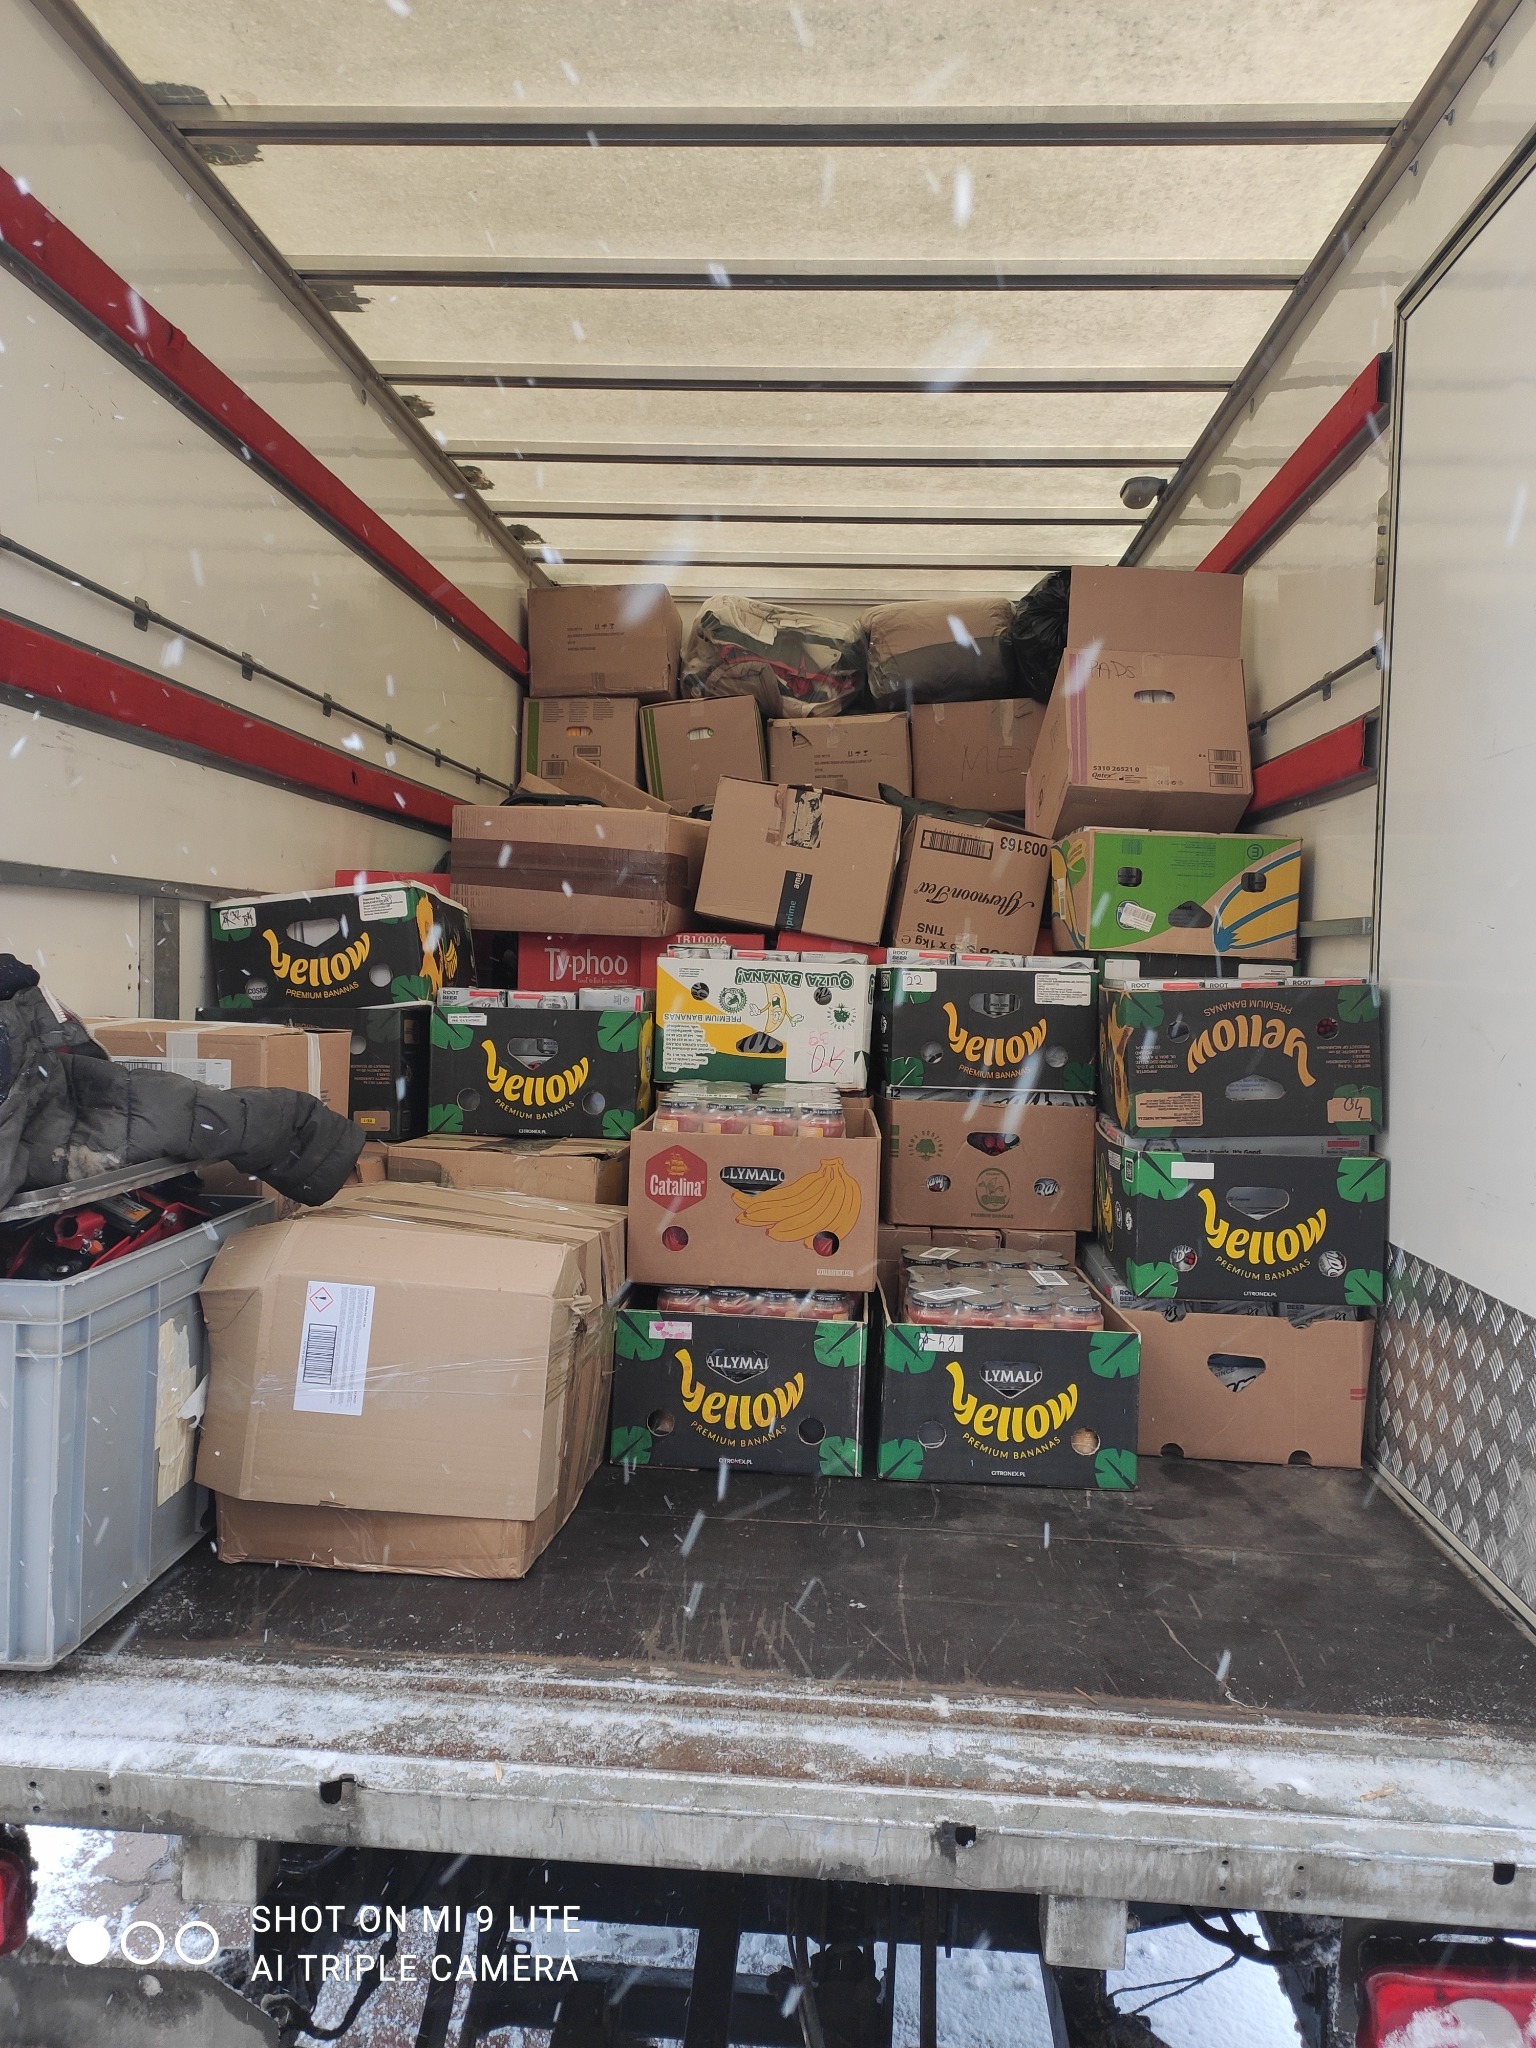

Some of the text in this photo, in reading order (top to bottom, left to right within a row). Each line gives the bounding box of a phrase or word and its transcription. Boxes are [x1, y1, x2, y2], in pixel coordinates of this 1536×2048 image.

[999, 836, 1048, 857] 003163
[915, 935, 935, 949] 1kg
[916, 922, 945, 937] TINS
[261, 928, 371, 987] yellow
[285, 981, 360, 1000] PREMIUM BANANAS
[663, 1013, 742, 1023] PREMIUM BANANAS
[1203, 999, 1292, 1017] PREMIUM BANANAS
[942, 1001, 1047, 1067] yellow
[1187, 1014, 1317, 1088] yellow
[481, 1037, 589, 1107] yellow
[958, 1064, 994, 1079] PREMIUM
[494, 1098, 576, 1120] PREMIUM BANANAS
[650, 1175, 702, 1197] Catalina
[1197, 1188, 1328, 1266] yellow
[1215, 1255, 1311, 1282] PREMIUM BANANAS
[674, 1348, 806, 1431] yellow
[945, 1361, 1078, 1443] yellow
[690, 1420, 787, 1449] PREMIUM BANANAS
[962, 1432, 1061, 1460] PREMIUM BANANAS
